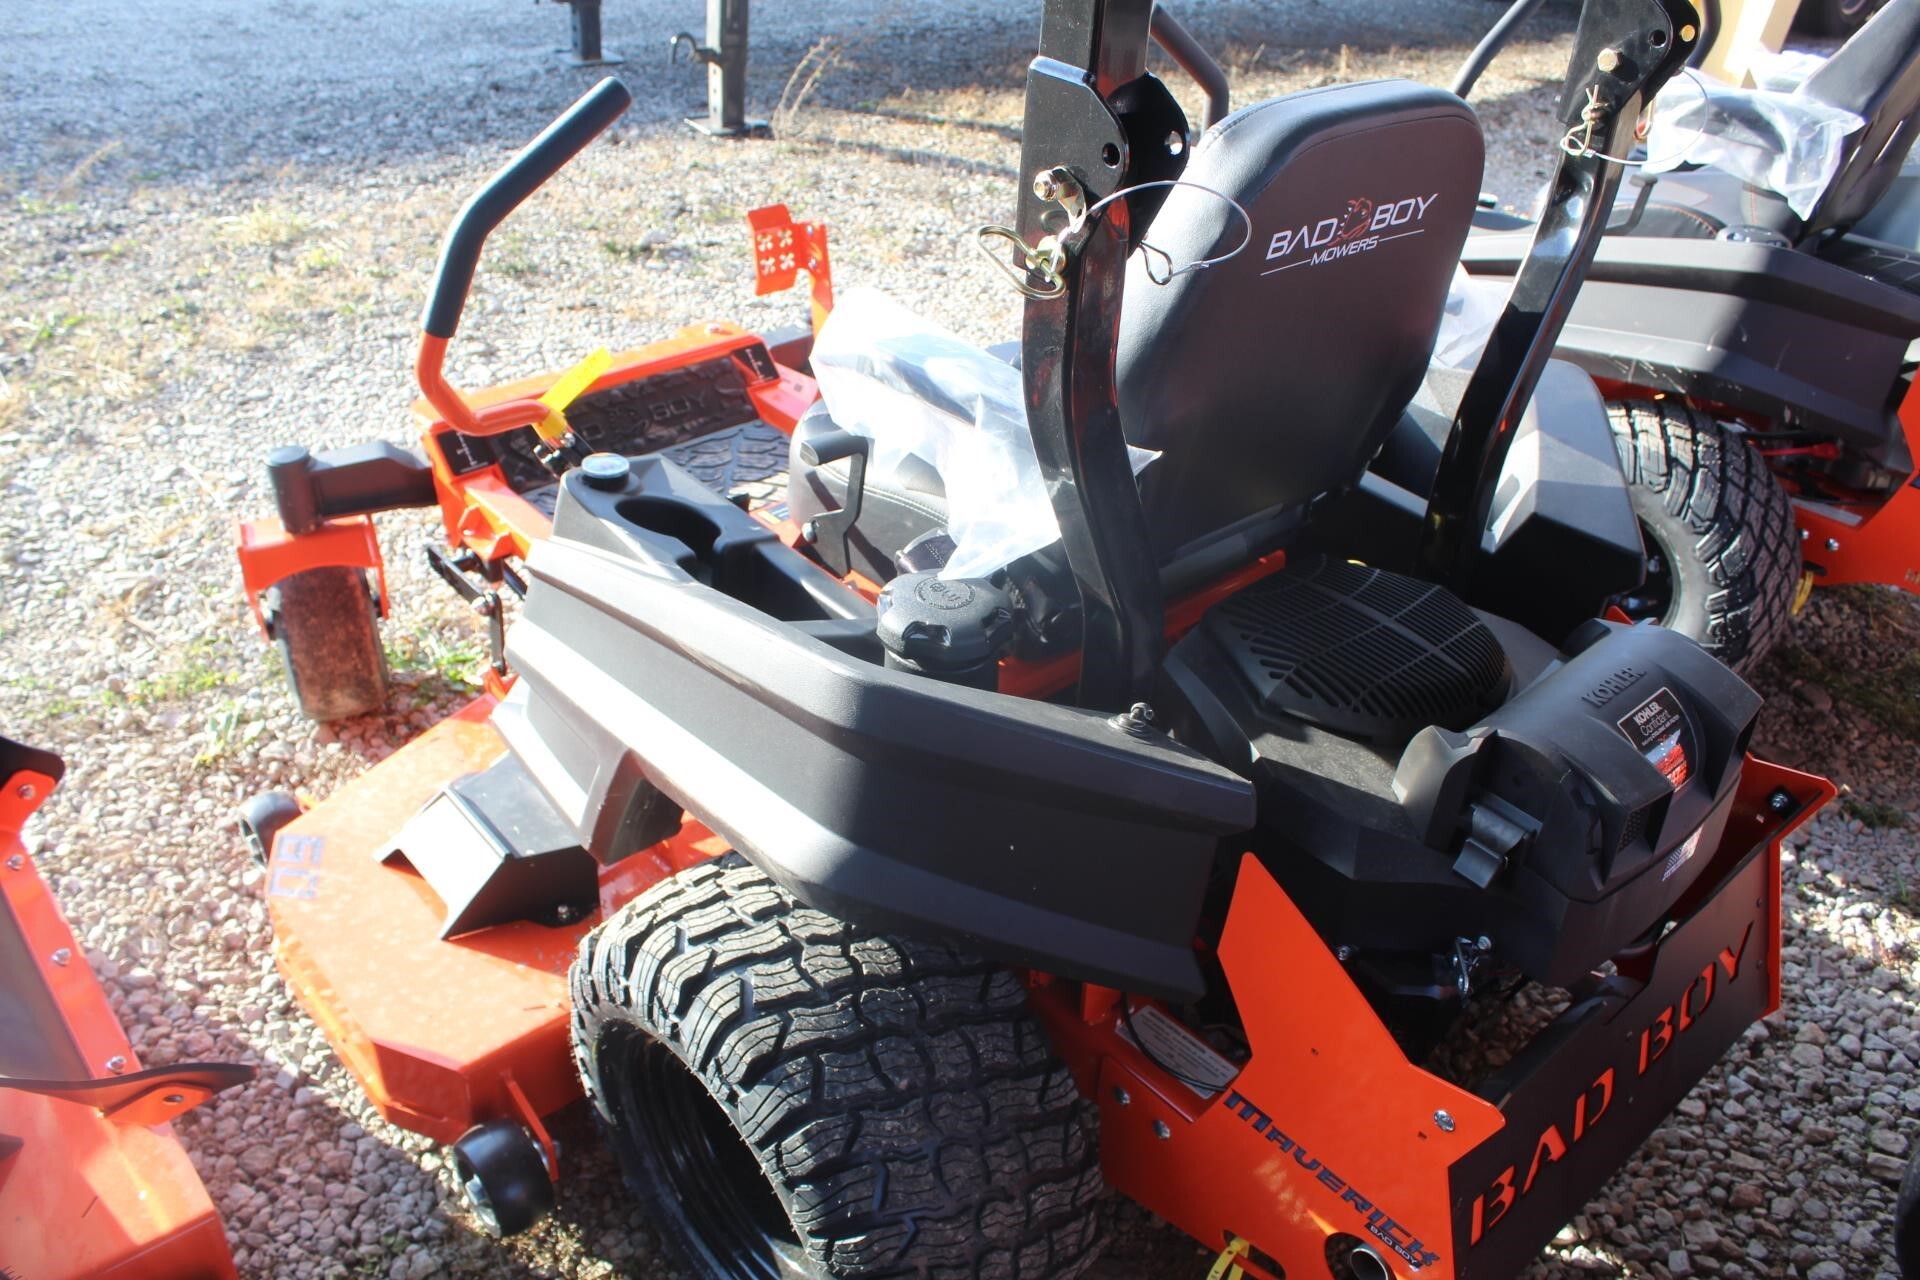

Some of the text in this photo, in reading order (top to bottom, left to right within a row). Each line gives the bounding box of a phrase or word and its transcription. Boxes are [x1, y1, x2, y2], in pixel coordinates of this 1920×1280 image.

[1266, 193, 1439, 260] BAD BOY
[1310, 235, 1379, 266] MOWERS
[1581, 667, 1648, 709] KOHLER
[1632, 701, 1663, 726] KOHLER
[1470, 921, 1754, 1247] BAD BOY
[1223, 1089, 1440, 1267] MAVERICK
[1370, 1225, 1418, 1264] BAD BOY
